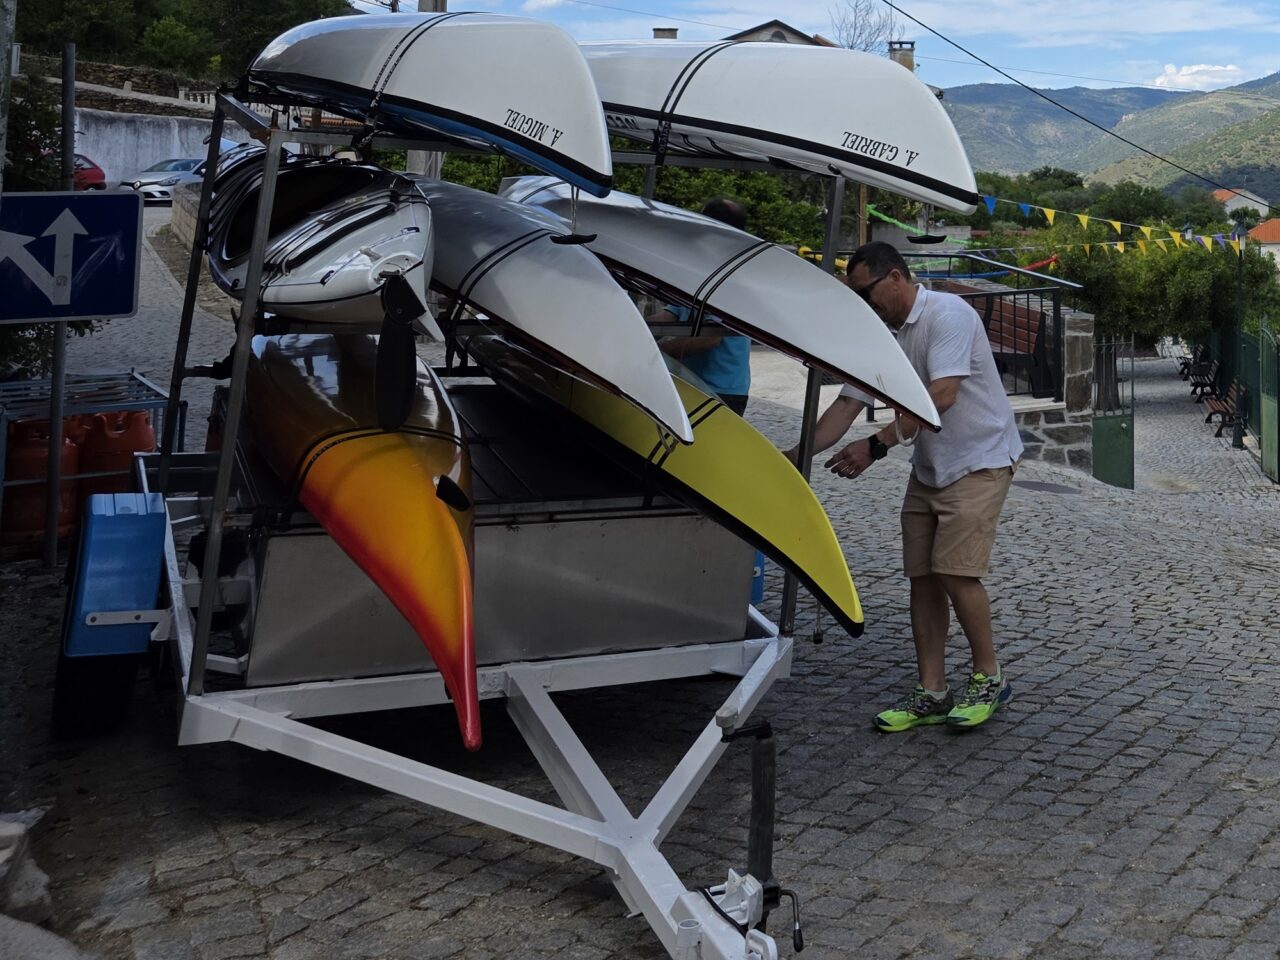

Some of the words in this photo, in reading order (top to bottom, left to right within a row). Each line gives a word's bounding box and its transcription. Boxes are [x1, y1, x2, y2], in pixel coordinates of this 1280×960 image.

[503, 108, 549, 141] MIGUEL
[550, 127, 564, 147] A.
[841, 131, 899, 162] GABRIEL
[905, 149, 920, 167] A.
